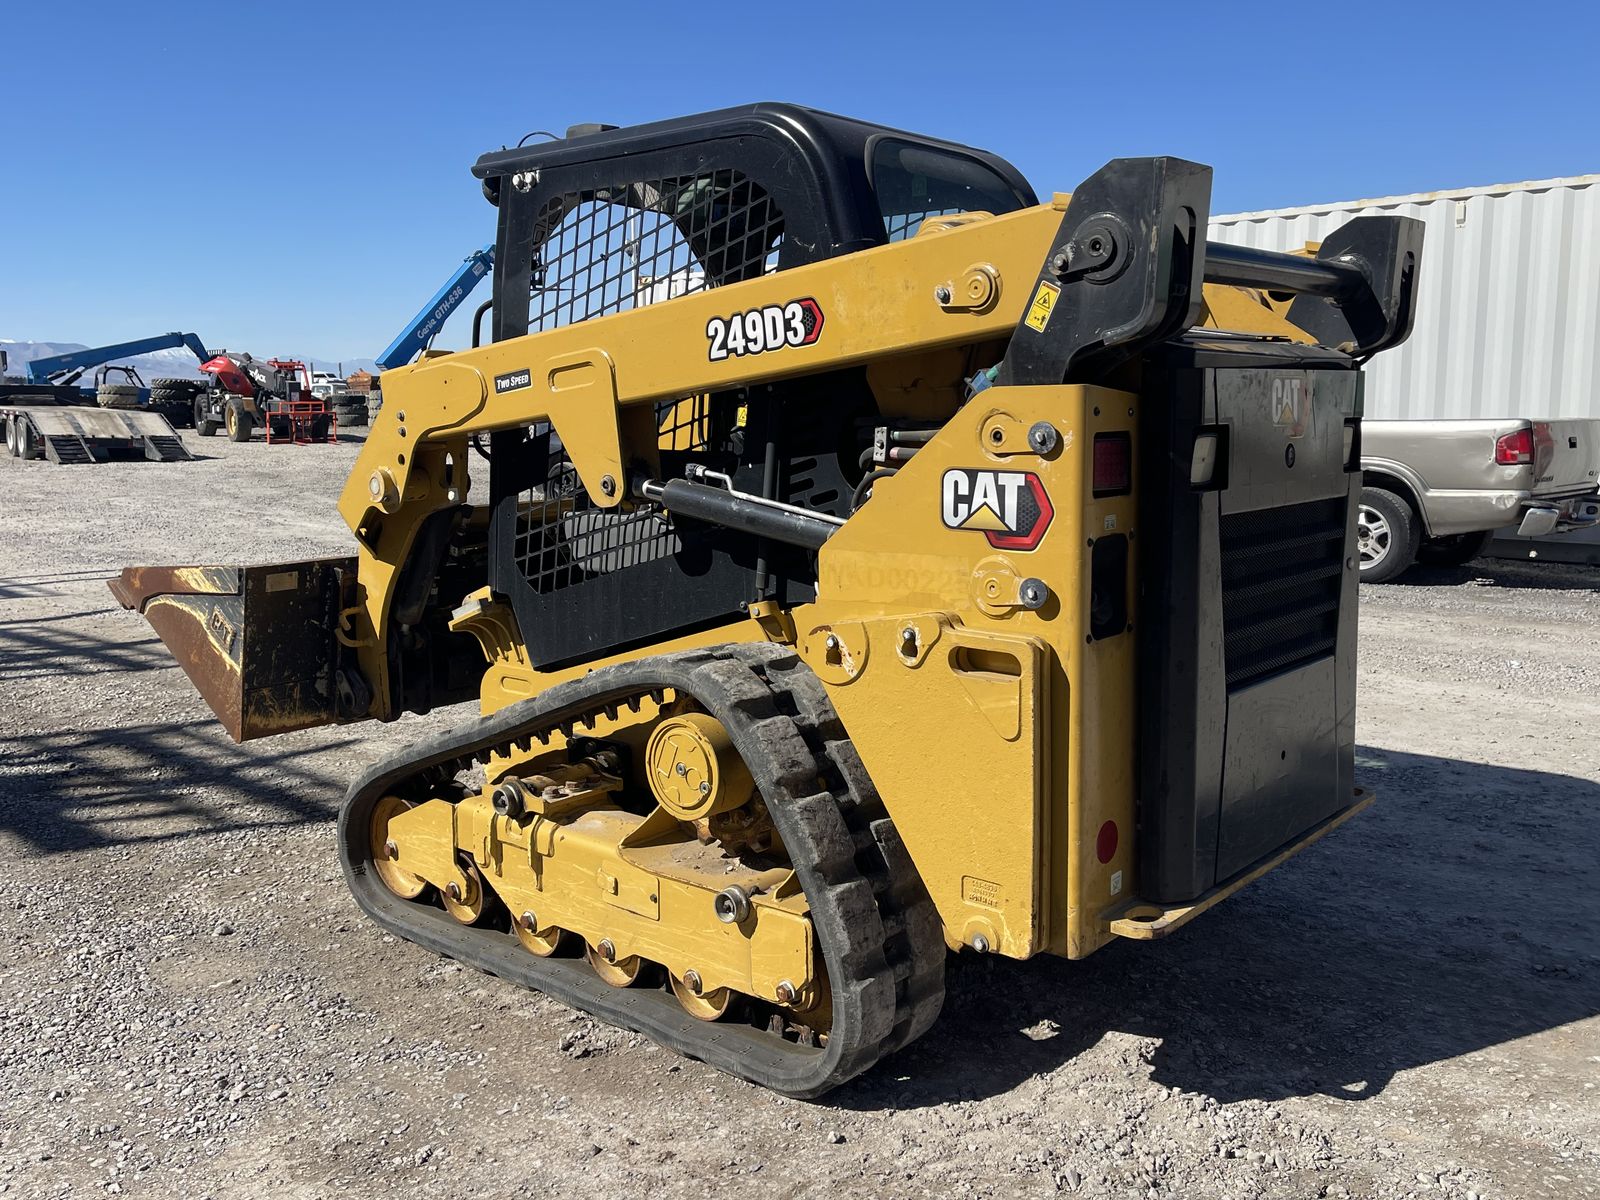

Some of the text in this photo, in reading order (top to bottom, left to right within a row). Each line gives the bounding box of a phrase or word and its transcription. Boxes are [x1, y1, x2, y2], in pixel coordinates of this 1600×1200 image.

[417, 286, 463, 339] Genie GTH-636
[707, 302, 805, 360] 249D3
[496, 374, 529, 390] TWO SPEED
[1271, 378, 1301, 424] CAT
[943, 469, 1026, 532] CAT
